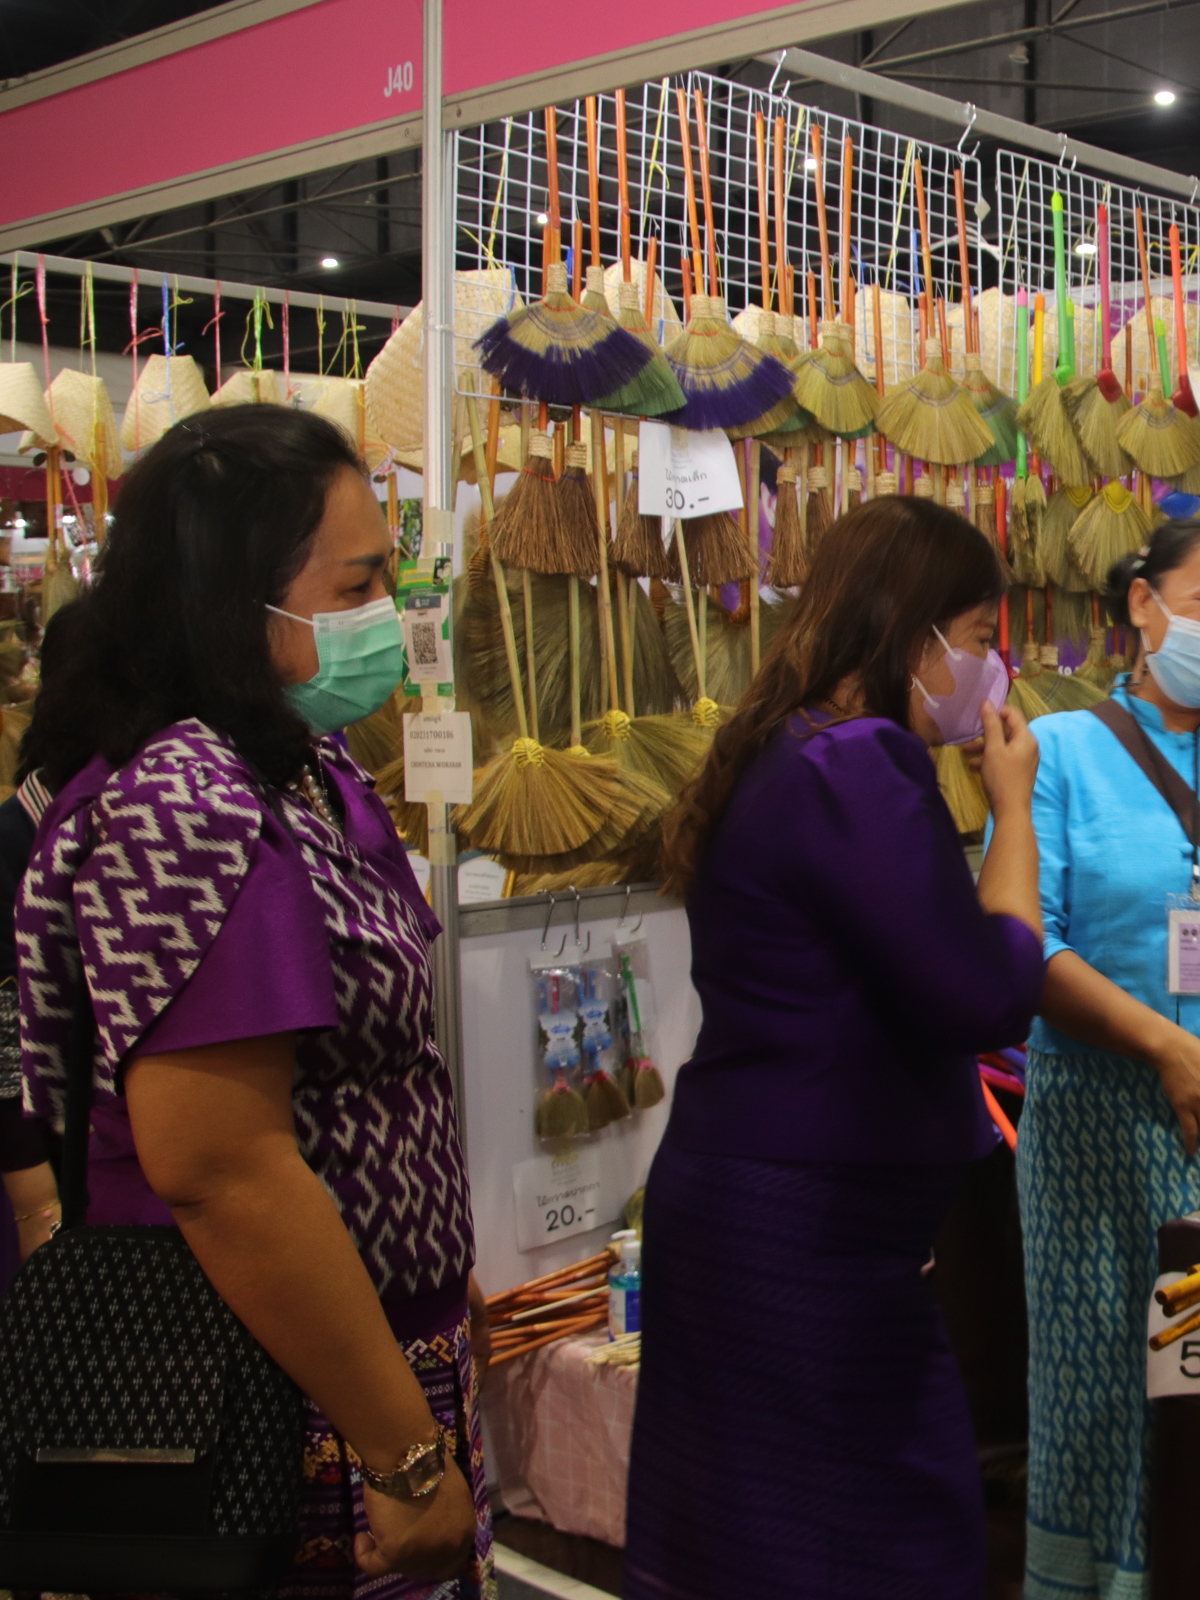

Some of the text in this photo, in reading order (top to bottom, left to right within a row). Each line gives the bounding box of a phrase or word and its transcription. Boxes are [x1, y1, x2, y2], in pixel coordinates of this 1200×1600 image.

[383, 61, 414, 98] J40
[664, 487, 710, 511] 30.-
[545, 1204, 596, 1232] 20.-
